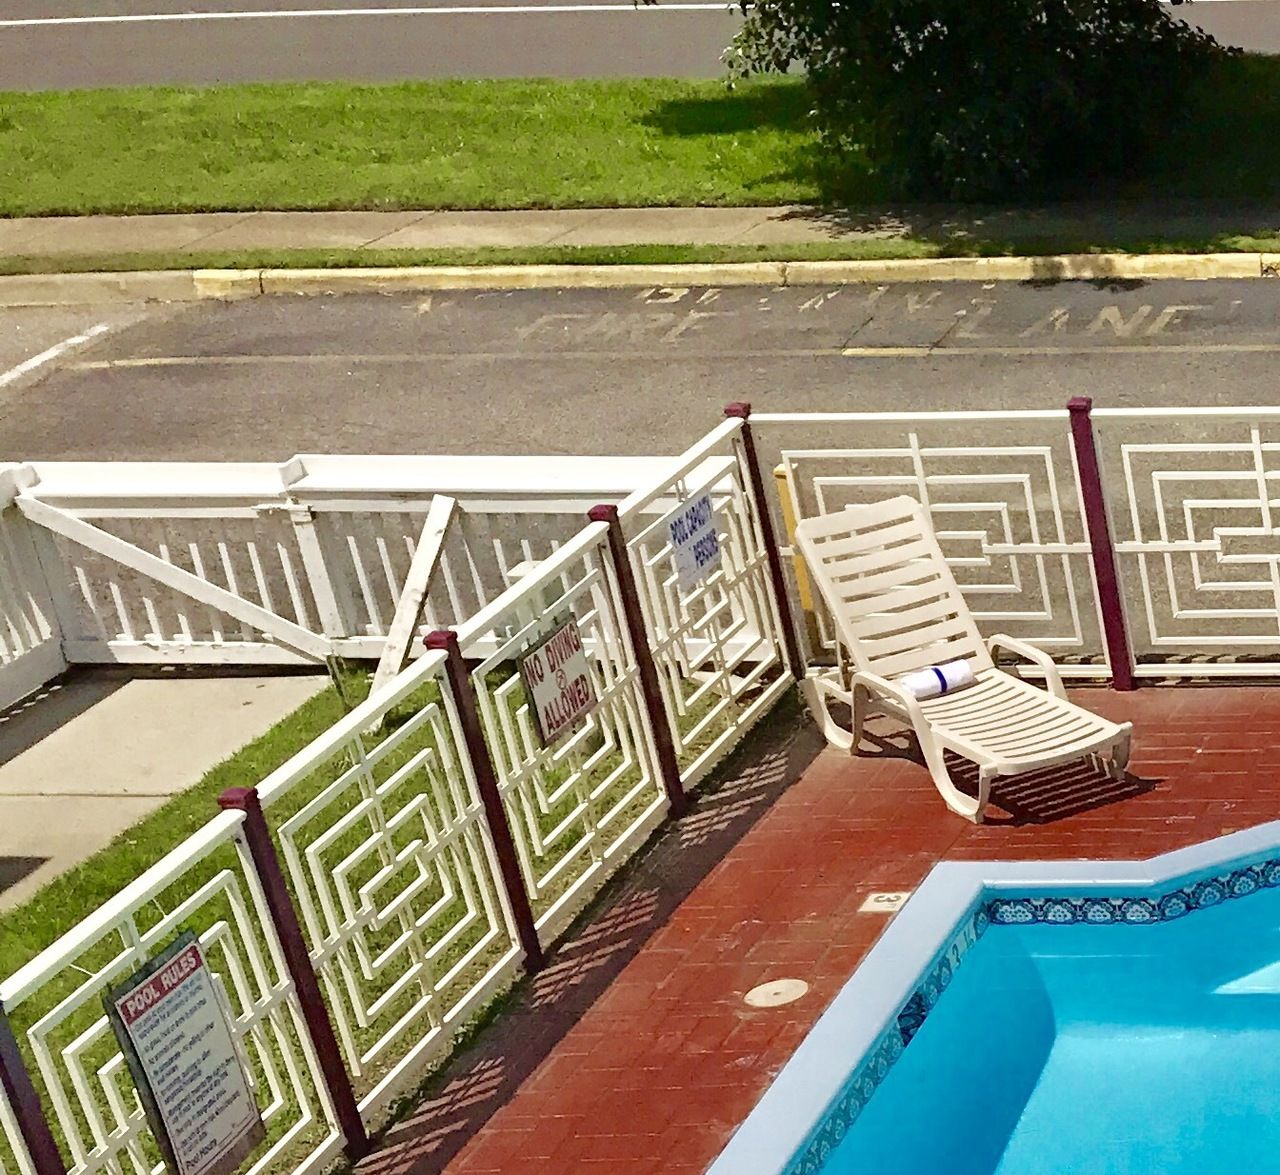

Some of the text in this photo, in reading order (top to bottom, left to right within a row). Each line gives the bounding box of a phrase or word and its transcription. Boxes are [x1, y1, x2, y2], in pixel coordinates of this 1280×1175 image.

[524, 623, 581, 689] NO DIVING
[544, 674, 589, 735] ALLOWED
[873, 895, 901, 903] 3
[125, 952, 197, 1016] POOL RULES
